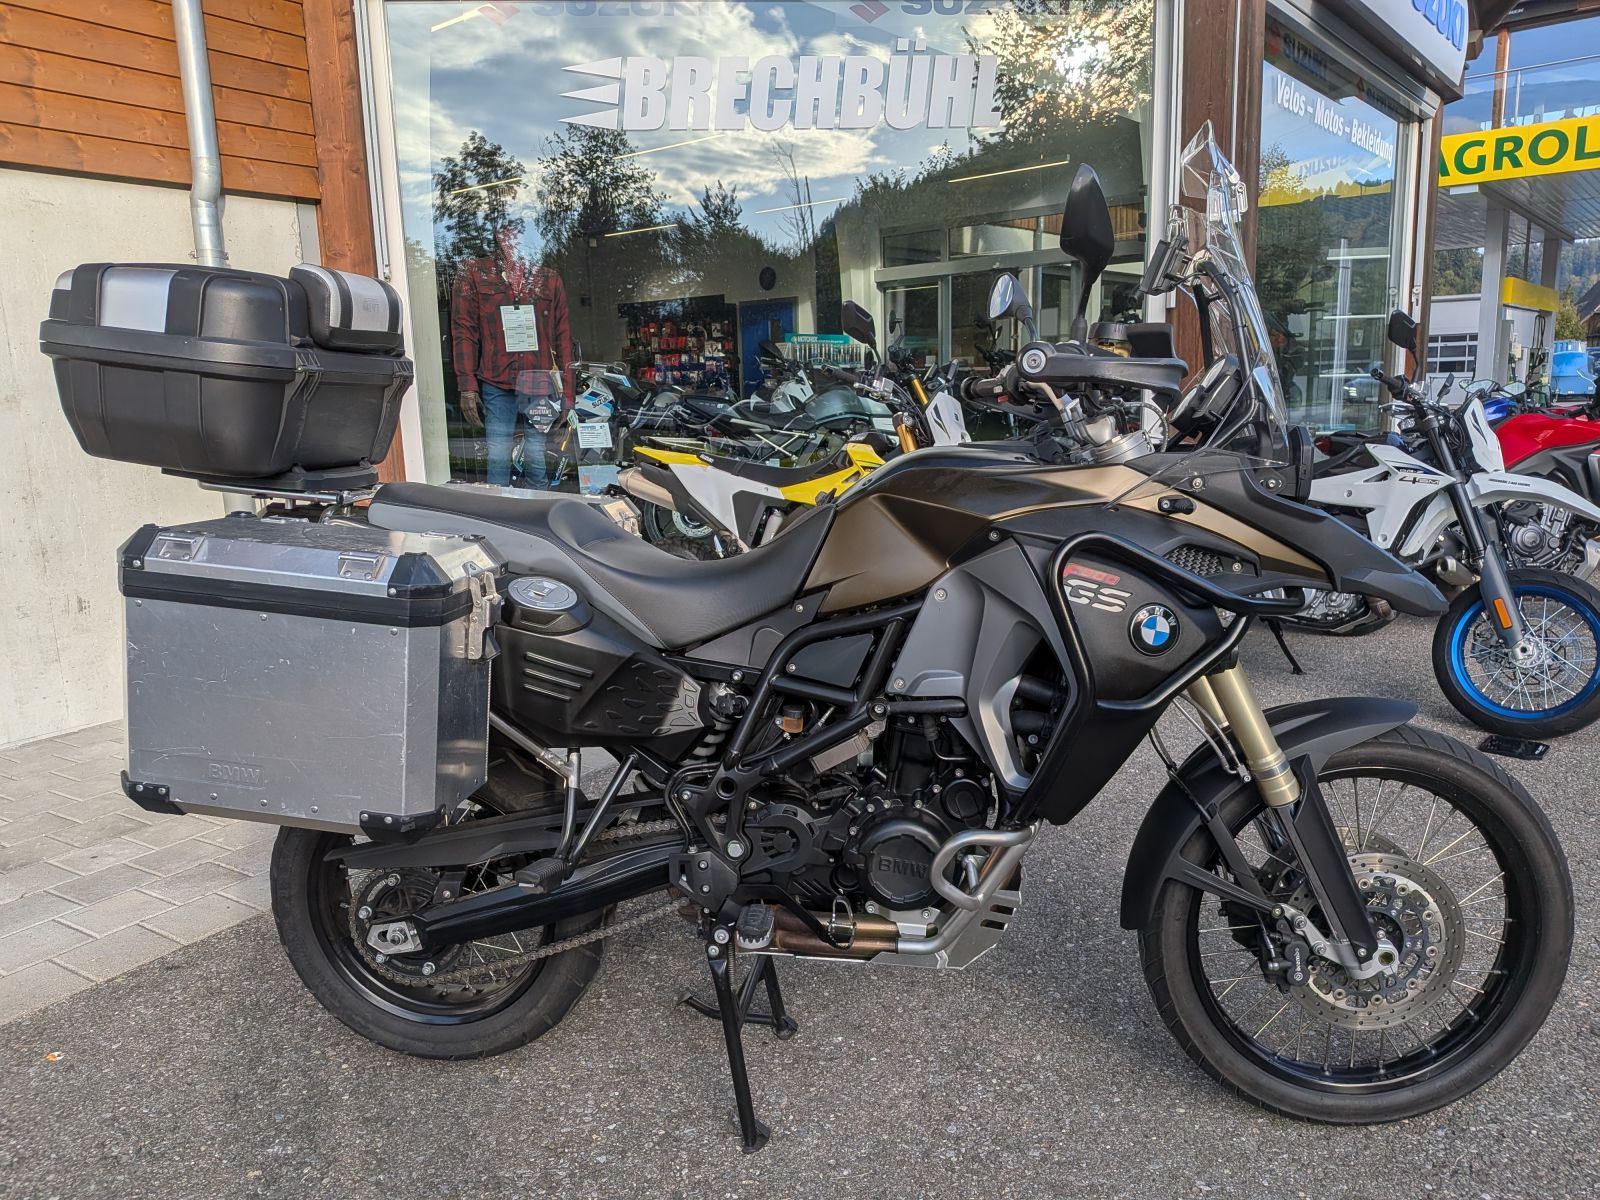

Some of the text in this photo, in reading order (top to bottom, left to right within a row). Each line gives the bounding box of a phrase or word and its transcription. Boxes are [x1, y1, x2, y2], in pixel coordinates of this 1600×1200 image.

[622, 38, 1001, 131] BRECHBÜHL
[1277, 73, 1305, 116] Velos
[1314, 98, 1344, 137] Motos
[1351, 118, 1394, 168] Bekleidung
[1064, 579, 1132, 613] GS
[208, 763, 261, 784] BMW
[879, 856, 929, 879] BMW
